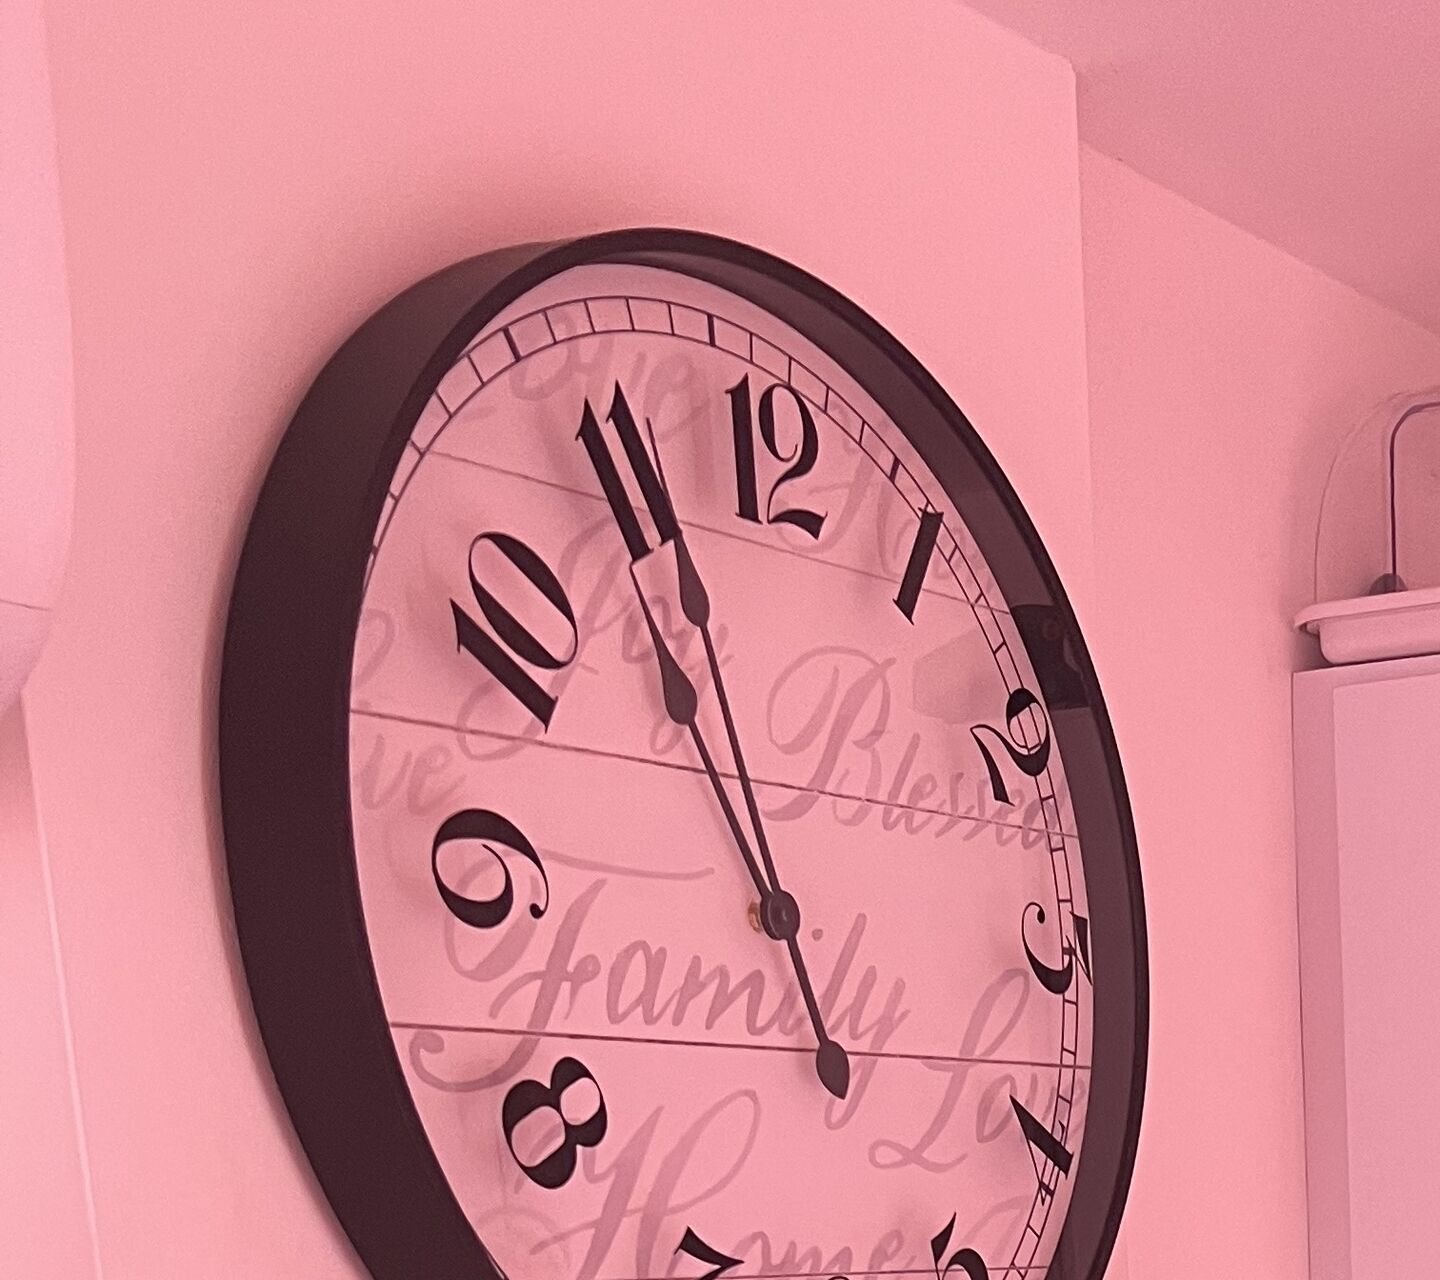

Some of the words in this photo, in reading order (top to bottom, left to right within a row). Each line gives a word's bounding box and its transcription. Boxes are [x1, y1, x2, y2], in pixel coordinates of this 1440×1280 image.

[575, 377, 683, 564] 11
[724, 371, 828, 540] 12
[450, 530, 578, 735] 10
[892, 507, 944, 626] 1
[761, 645, 1068, 851] Blessed
[970, 688, 1051, 808] 2
[431, 808, 549, 929] 9
[408, 847, 912, 1131] Family
[1022, 901, 1093, 995] 3
[501, 1056, 608, 1190] 8
[1009, 1094, 1075, 1206] 4
